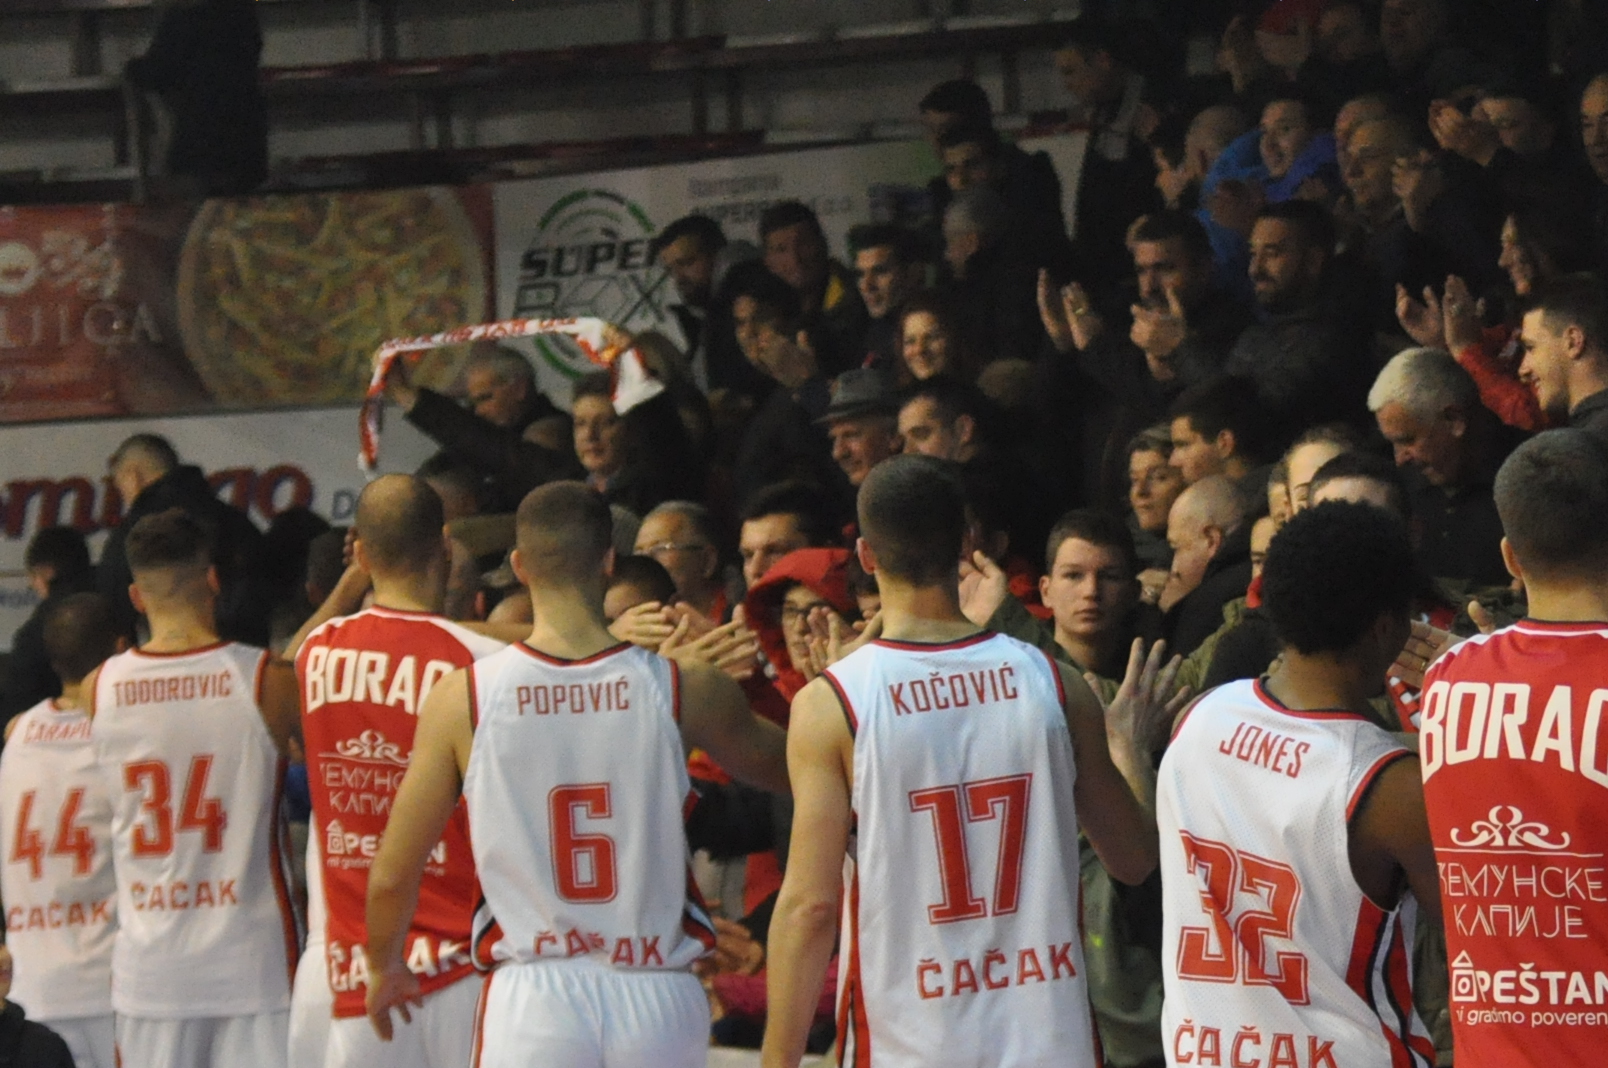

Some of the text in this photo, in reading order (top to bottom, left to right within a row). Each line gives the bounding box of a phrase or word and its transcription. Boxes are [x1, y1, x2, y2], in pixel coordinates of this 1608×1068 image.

[112, 669, 233, 708] TODOROVIĆ
[516, 676, 630, 716] POPOVIĆ
[888, 662, 1018, 717] KOČOVIĆ
[1218, 720, 1311, 779] JONES
[8, 787, 96, 883] 44
[122, 754, 228, 860] 34
[547, 782, 619, 905] 6
[908, 772, 1033, 926] 17
[1176, 828, 1311, 1007] 32
[916, 942, 1076, 1000] ČAČAK
